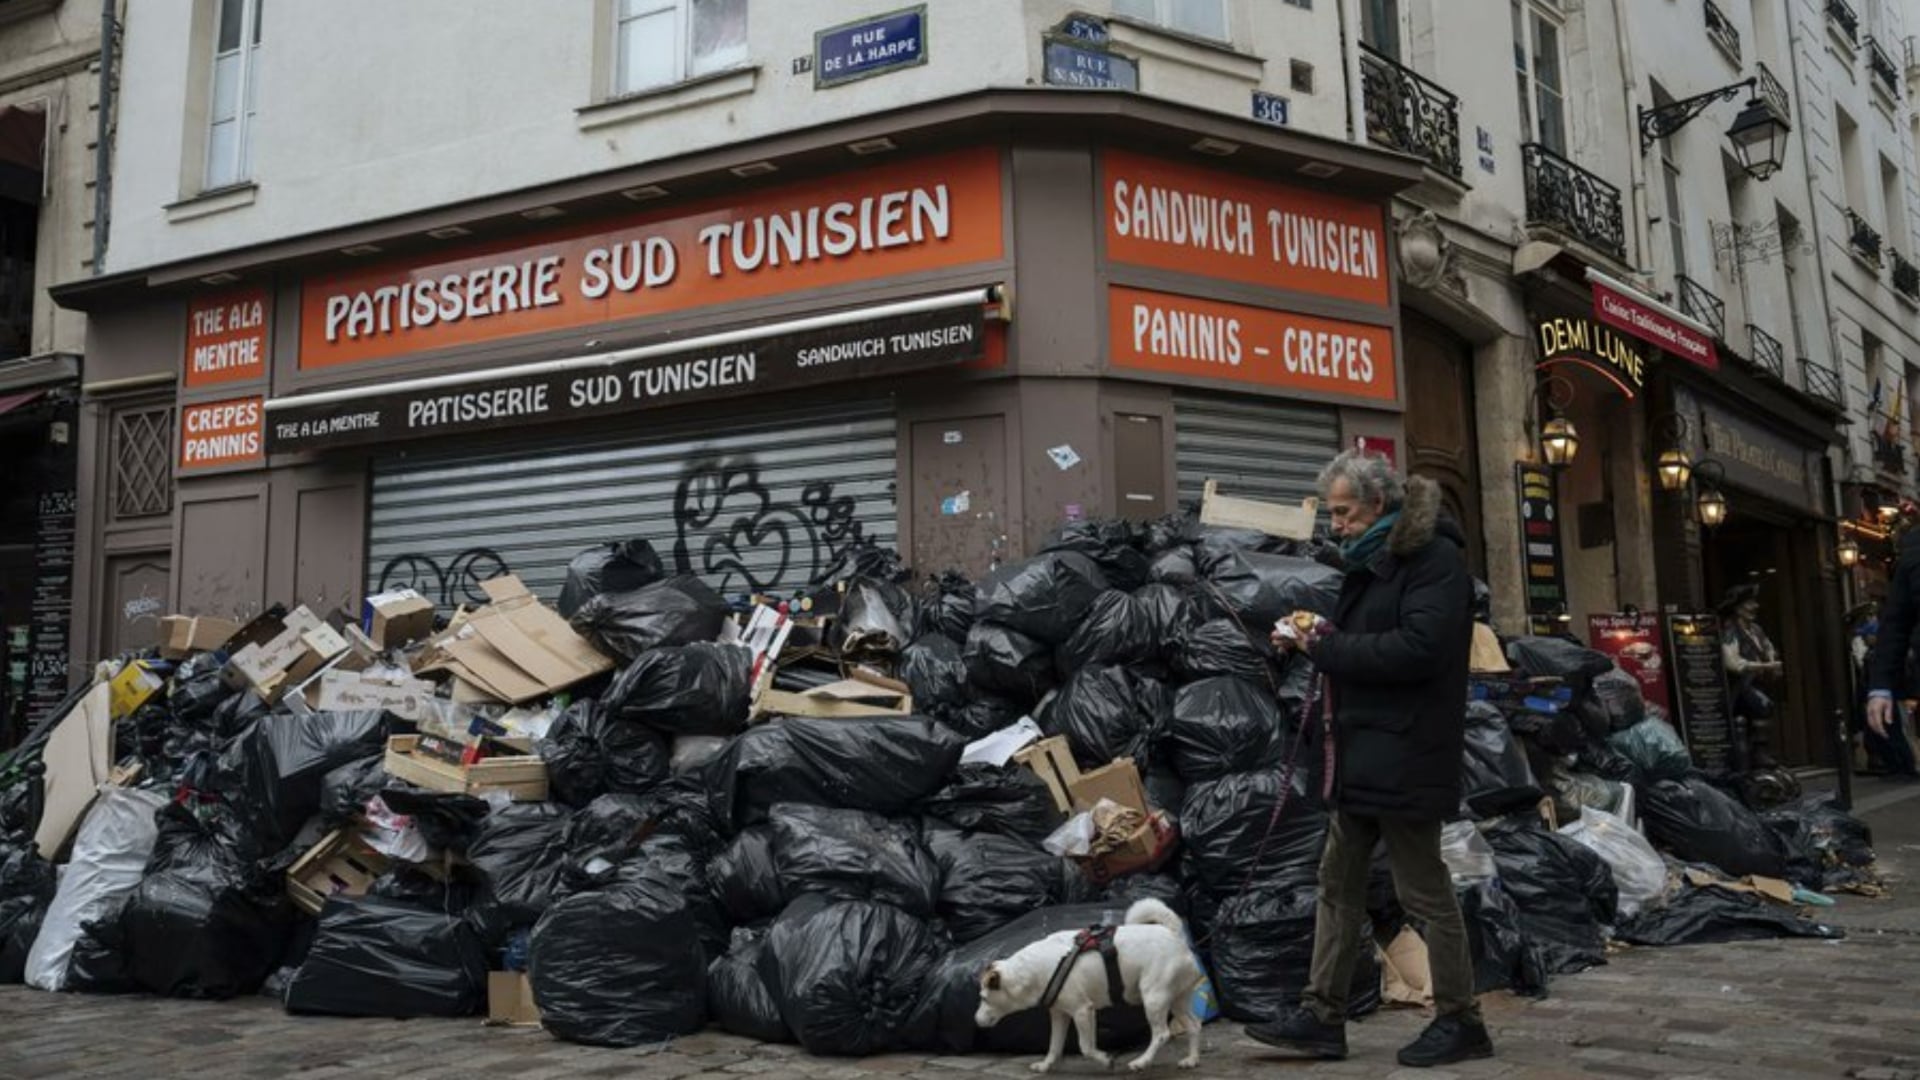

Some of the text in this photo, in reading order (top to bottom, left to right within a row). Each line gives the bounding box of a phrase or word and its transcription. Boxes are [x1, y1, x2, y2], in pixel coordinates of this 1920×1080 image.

[852, 27, 886, 47] RUE
[824, 38, 916, 72] DE LA HARPE
[1076, 54, 1108, 75] RUE
[1258, 95, 1284, 123] 36
[1114, 179, 1378, 278] SANDWICH TUNISIEN
[325, 184, 949, 342] PATISSERIE SUD TUNISIEN
[194, 307, 225, 336] THE
[194, 337, 260, 373] MENTHE
[796, 323, 973, 367] SANDWICH TUNISIEN
[1133, 304, 1242, 365] PANINIS
[1283, 326, 1374, 383] CREPES
[1541, 319, 1644, 387] DEMI LUNE
[408, 352, 756, 427] PATISSERIE SUD TUNISIEN
[187, 402, 258, 432] CREPES
[276, 411, 380, 440] THE A LA MENTHE
[185, 432, 258, 462] PANINIS
